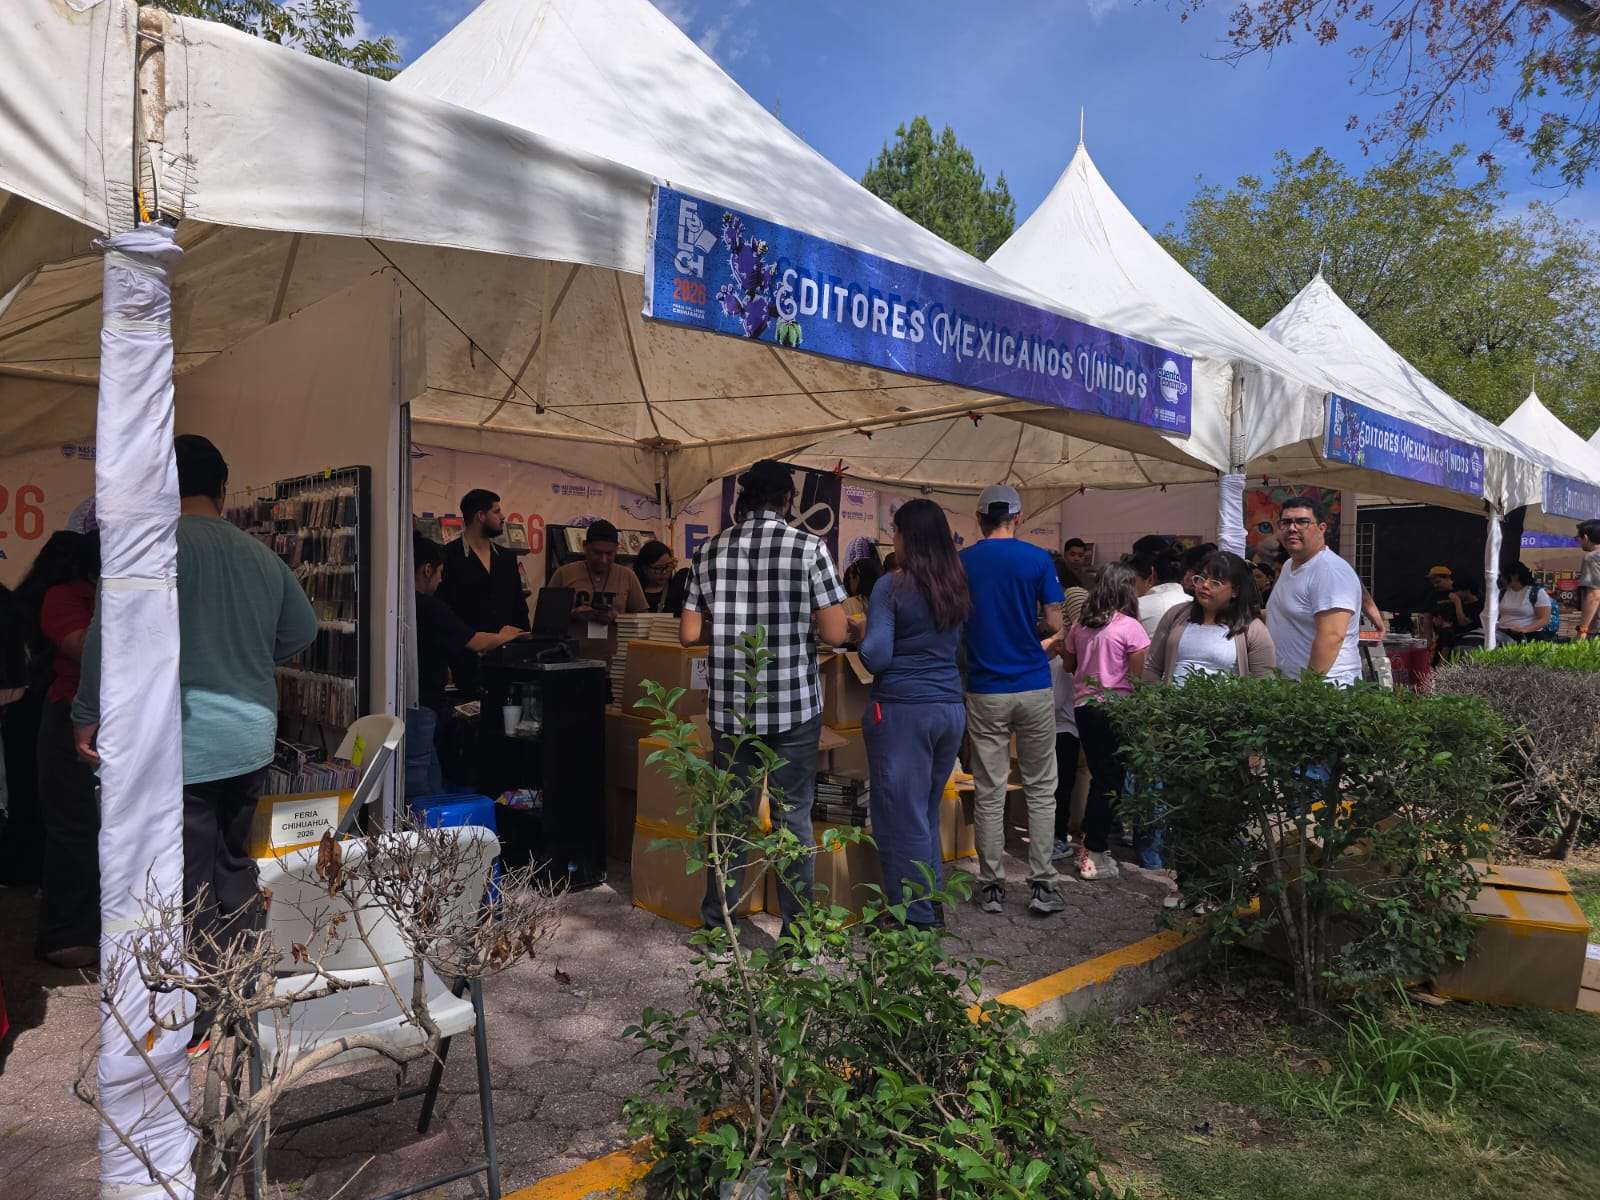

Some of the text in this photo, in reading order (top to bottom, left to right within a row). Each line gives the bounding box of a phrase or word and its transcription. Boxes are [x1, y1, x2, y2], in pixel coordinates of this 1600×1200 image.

[775, 268, 1149, 399] EDITORES MEXICANOS UNIDOS
[1358, 420, 1400, 454] EDITORES
[1400, 434, 1444, 468] MEXICANOS
[1444, 447, 1470, 475] UNIDOS
[294, 810, 319, 819] FERIA
[281, 818, 329, 831] CHIHUAHUA
[296, 830, 315, 838] 2026
